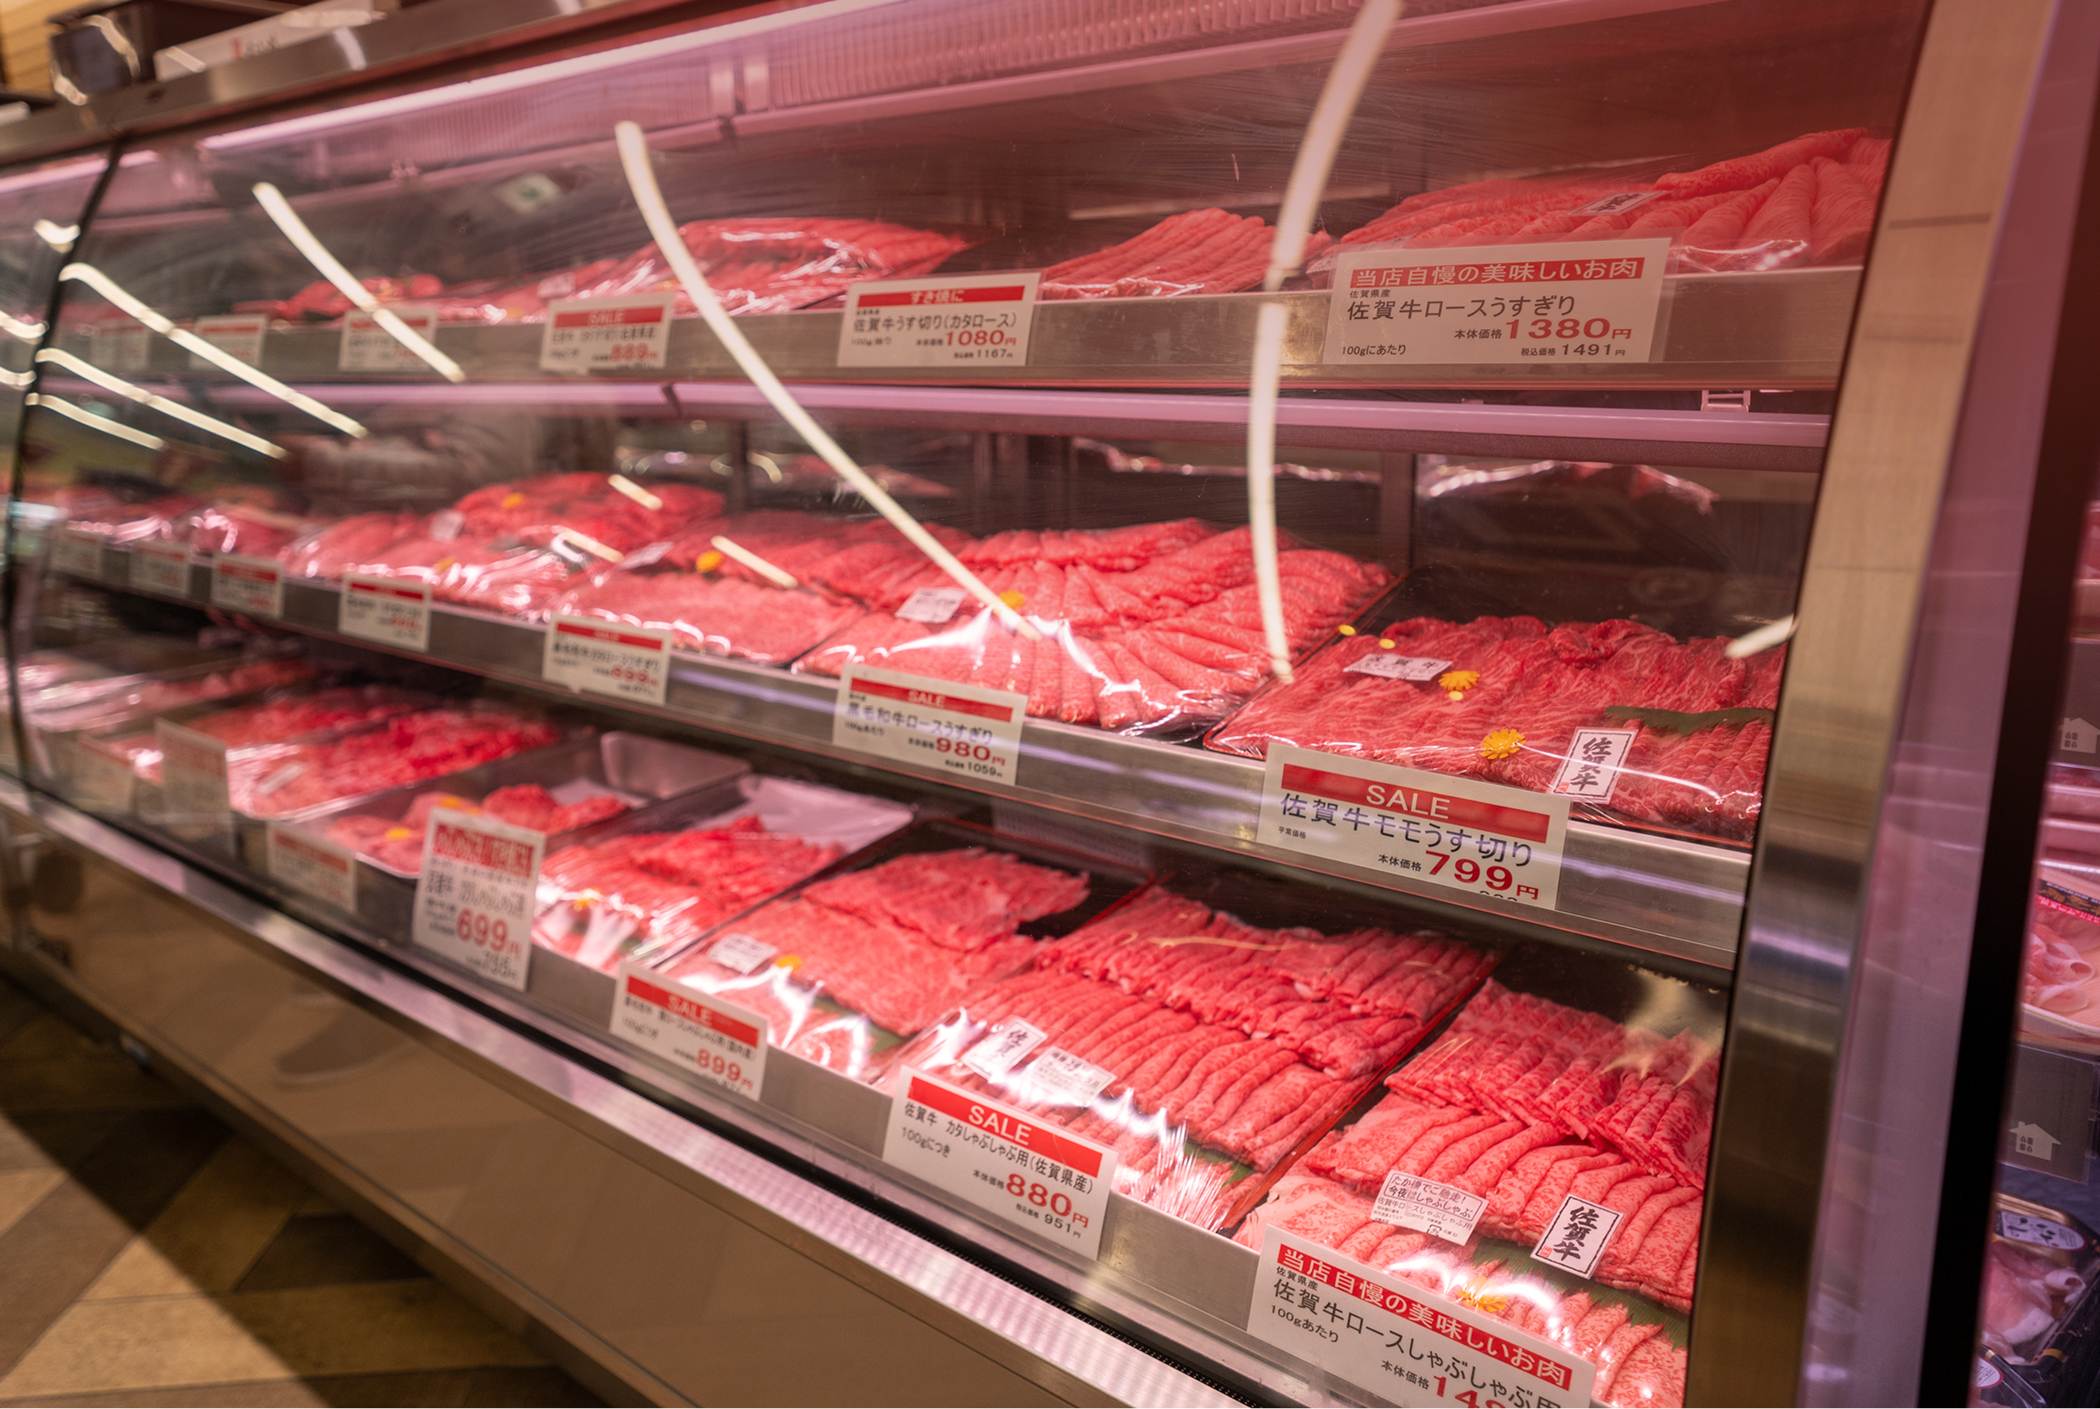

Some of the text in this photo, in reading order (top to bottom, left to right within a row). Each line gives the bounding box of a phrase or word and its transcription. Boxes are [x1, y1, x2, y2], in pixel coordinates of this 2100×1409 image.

[1356, 258, 1639, 287] 当店自慢の美味しいお肉
[910, 289, 965, 304] すき焼に
[1347, 295, 1576, 321] 佐賀牛ロースうすぎり
[1350, 288, 1391, 299] 佐賀県産
[945, 329, 1017, 347] 1080円
[1454, 318, 1632, 340] 本体価格 1380円
[1341, 344, 1406, 357] 100gにあたり
[1520, 343, 1626, 357] 税込価格 1491円
[906, 689, 946, 708] SALE
[846, 701, 993, 745] 黒毛和牛ロースうすぎり
[935, 737, 1006, 767] 980円
[1570, 736, 1613, 792] 佐賀牛
[1365, 784, 1450, 820] SALE
[1280, 792, 1532, 868] 佐賀牛モモうす切り
[1377, 850, 1540, 900] 本体価格 799円
[667, 994, 714, 1027] SALE
[697, 1048, 754, 1091] 899円
[967, 1104, 1032, 1146] SALE
[901, 1126, 952, 1158] 100gにつき
[903, 1101, 1095, 1196] 佐賀牛 カタしゃぶしゃぶ用(佐賀県産)
[1005, 1172, 1090, 1229] 880円
[1043, 1212, 1082, 1239] 951円
[1553, 1205, 1601, 1262] 佐賀牛
[1276, 1265, 1319, 1291] 佐賀県産
[1270, 1303, 1340, 1344] 100gあたり
[1281, 1248, 1567, 1388] 当店自慢の美味しいお肉
[1380, 1359, 1430, 1391] 本体価格
